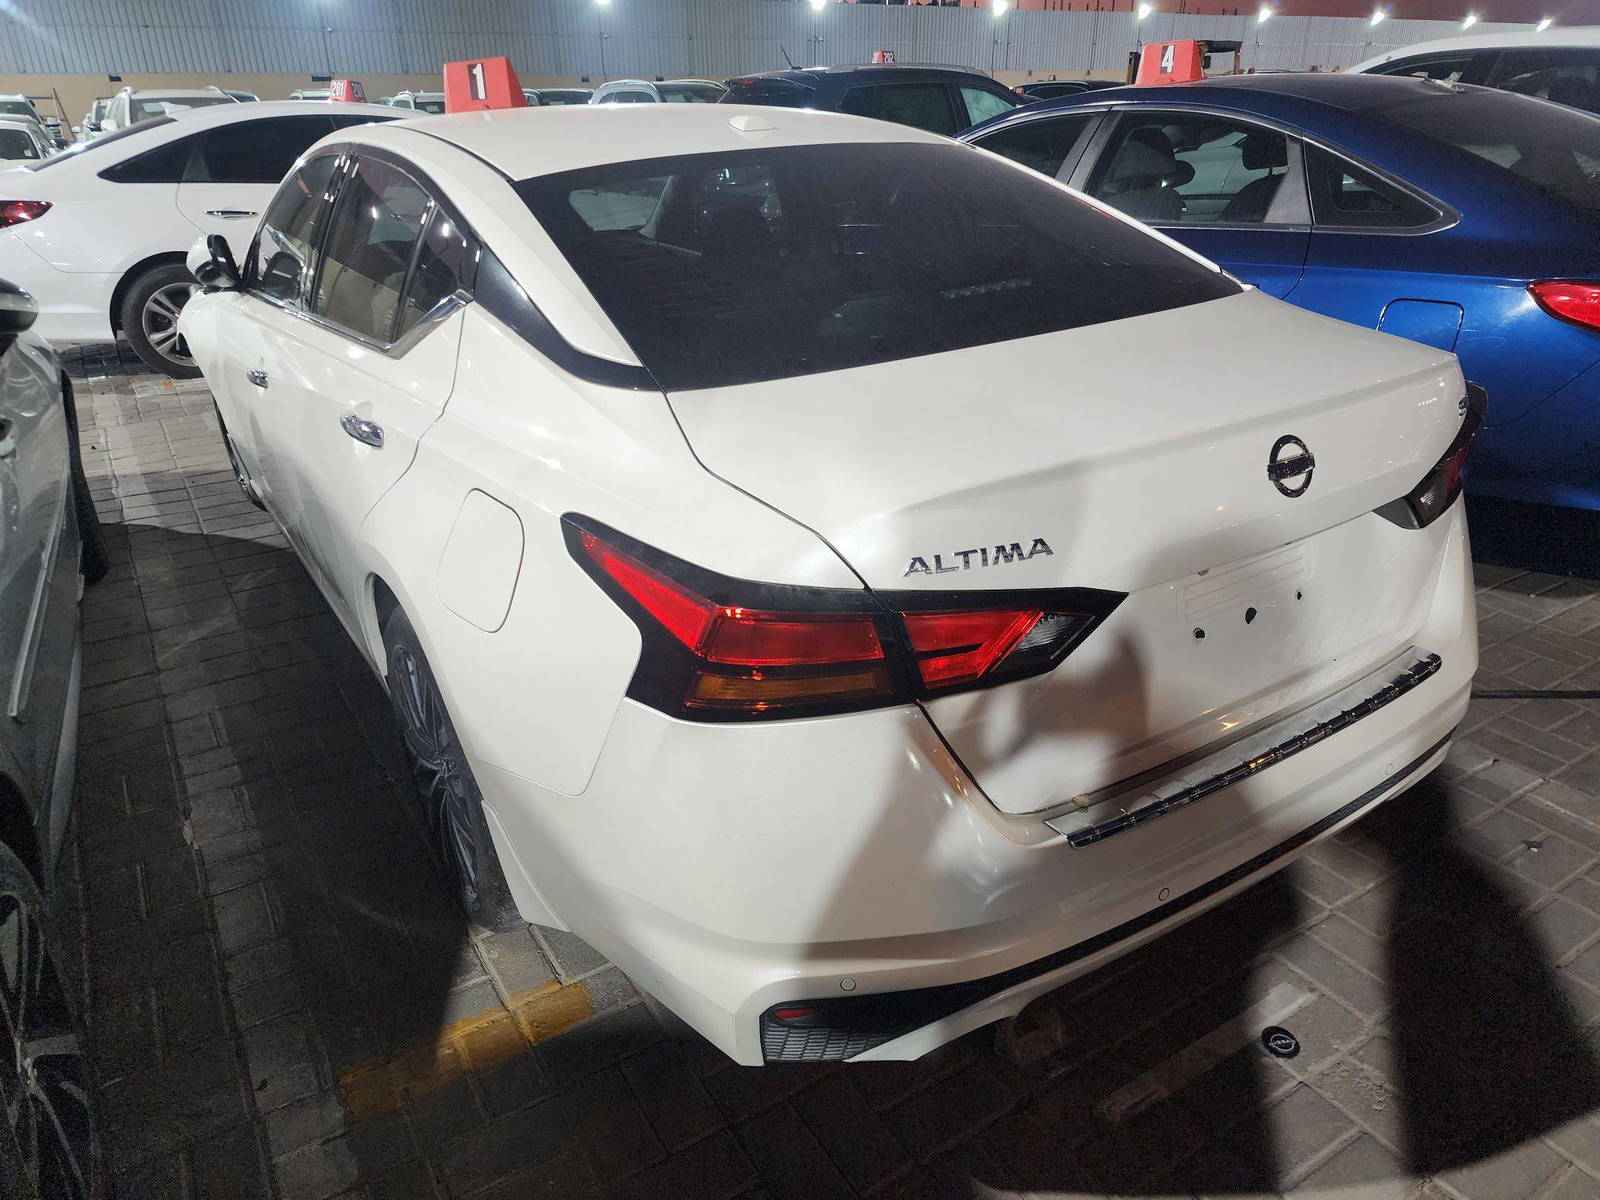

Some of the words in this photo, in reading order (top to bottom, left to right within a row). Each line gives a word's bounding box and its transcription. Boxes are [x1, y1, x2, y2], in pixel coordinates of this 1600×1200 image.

[1161, 45, 1175, 73] 4
[472, 63, 486, 100] 1
[903, 537, 1054, 577] ALTIMA
